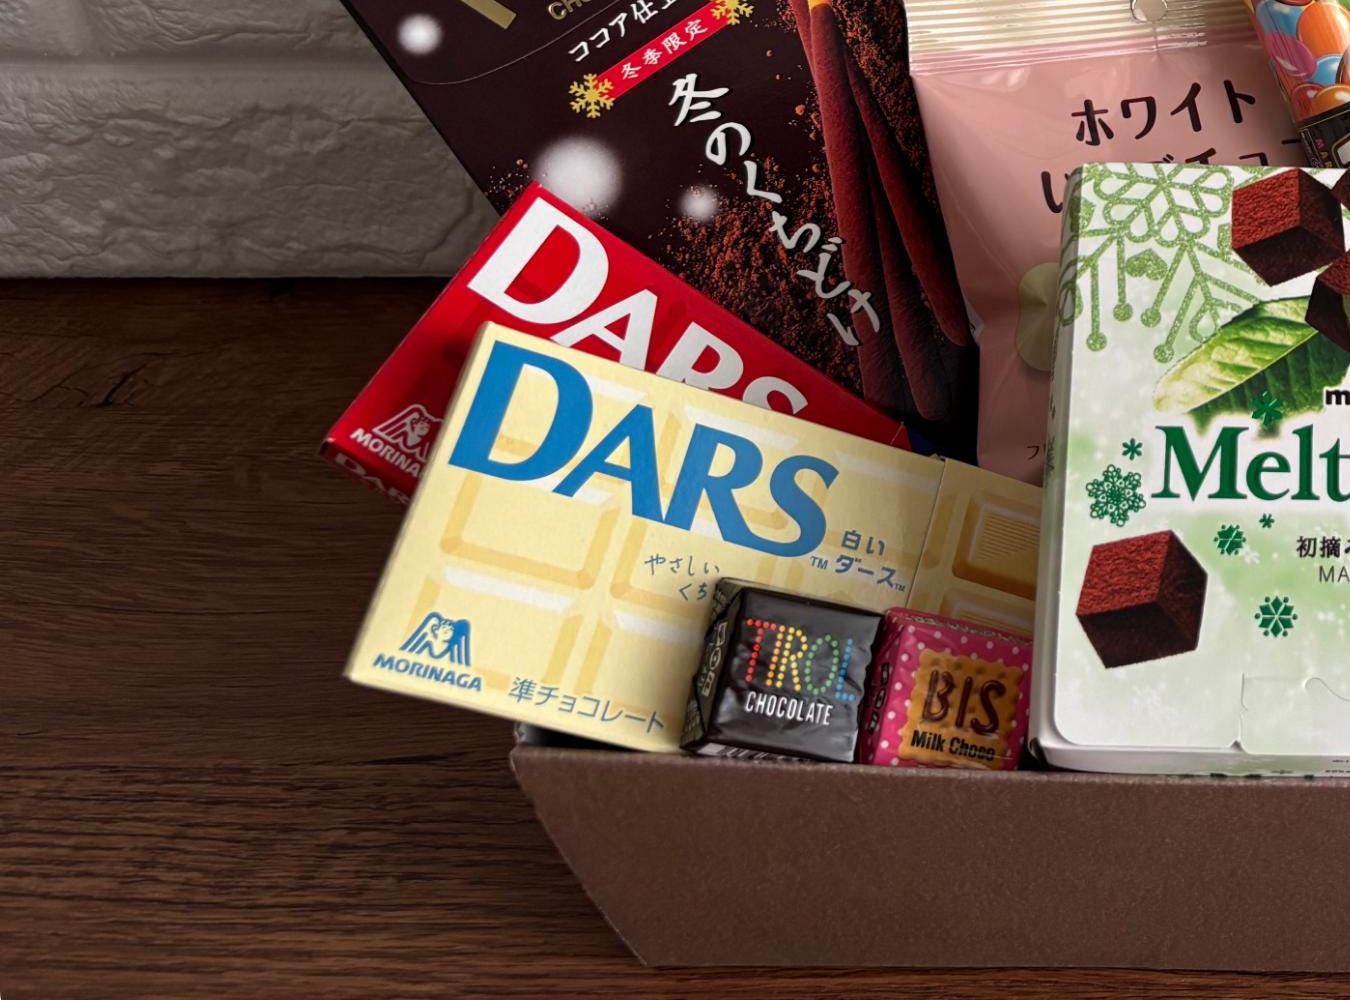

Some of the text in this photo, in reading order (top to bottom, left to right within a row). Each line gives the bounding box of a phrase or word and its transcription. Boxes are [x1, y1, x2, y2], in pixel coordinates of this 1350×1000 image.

[620, 18, 708, 80] 冬季限定
[1070, 80, 1256, 146] ホワイト
[668, 73, 880, 346] 冬のくちどけ
[448, 341, 840, 558] DARS
[644, 554, 720, 577] やさしい
[835, 555, 898, 588] ダース
[842, 530, 885, 556] 白い
[372, 654, 483, 692] MORINAGA
[747, 618, 855, 701] TIROL
[508, 676, 665, 734] 準チョコレート
[744, 691, 833, 726] CHOCOLATE
[922, 670, 1006, 735] BIS
[911, 730, 945, 750] Milk
